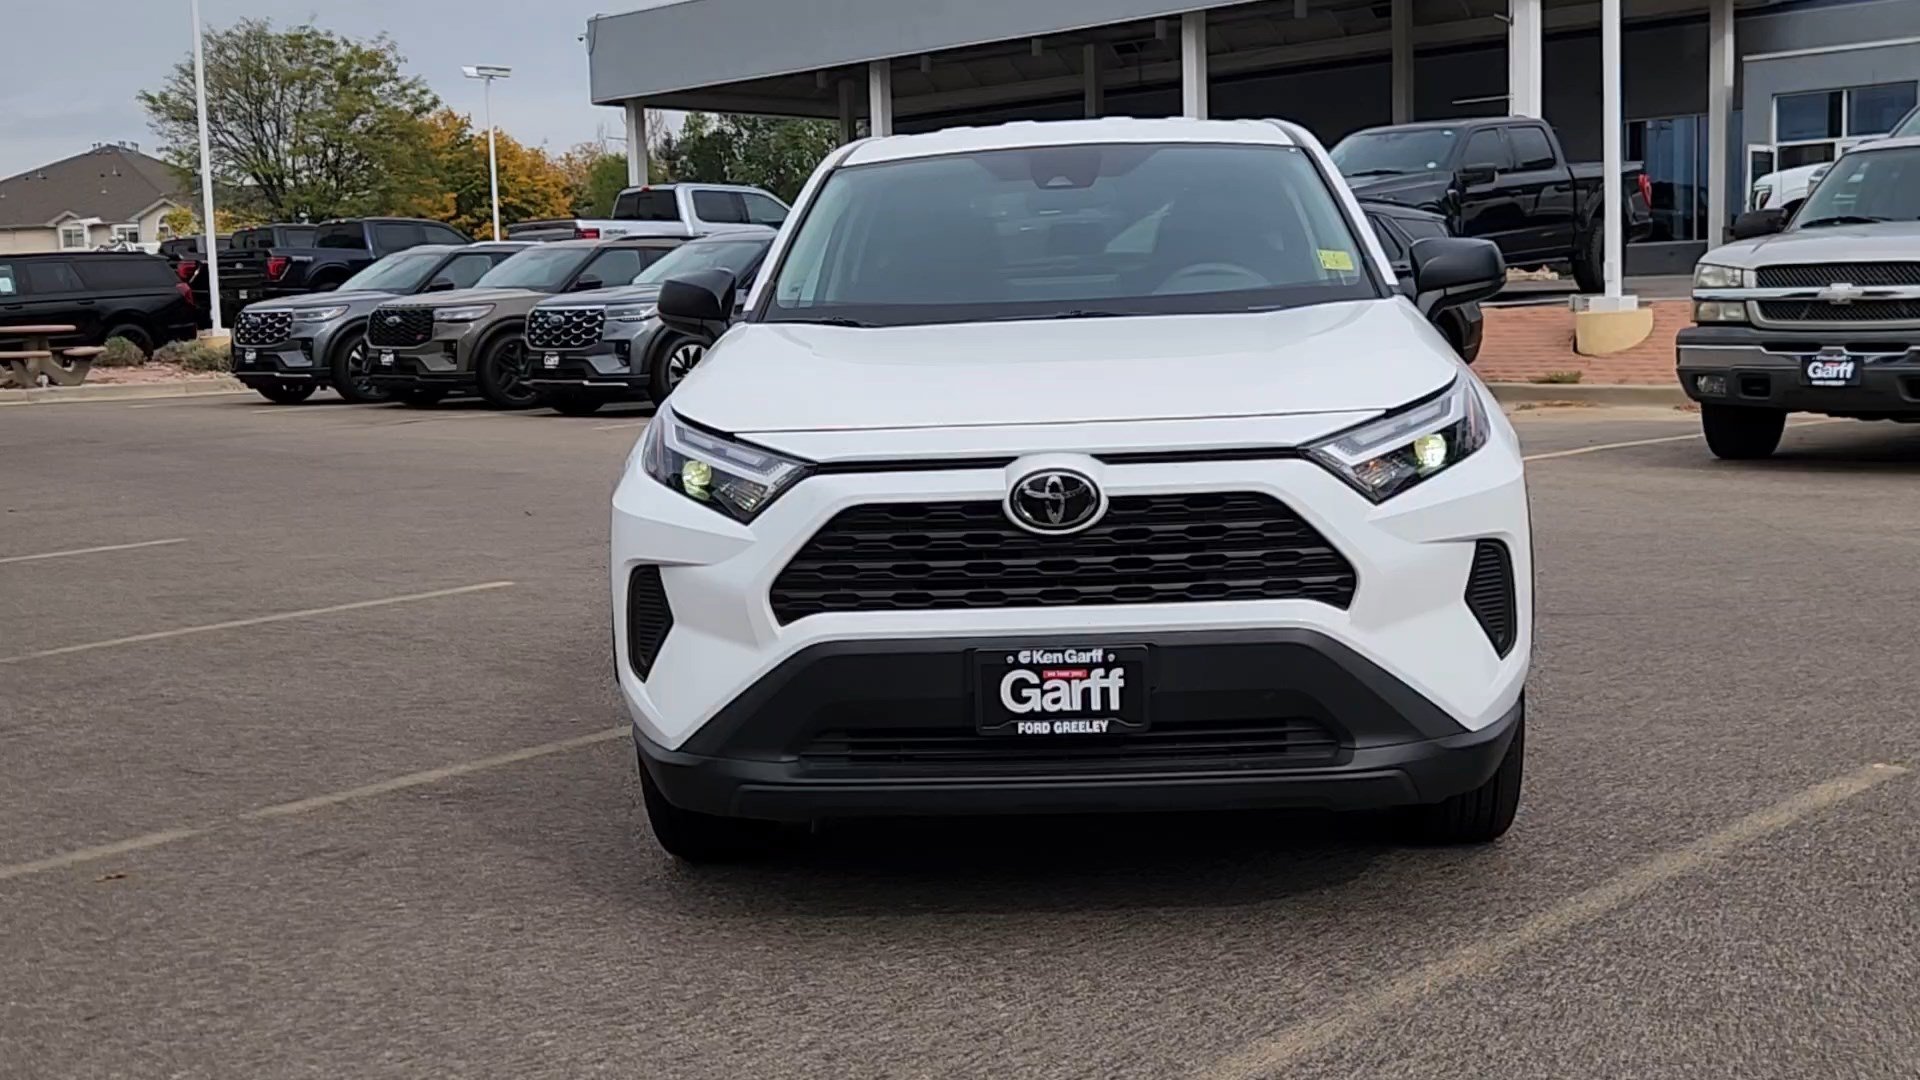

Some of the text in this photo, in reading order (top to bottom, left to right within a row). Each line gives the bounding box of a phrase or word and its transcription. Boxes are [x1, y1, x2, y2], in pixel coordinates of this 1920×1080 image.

[1807, 361, 1855, 379] Garff
[1032, 649, 1063, 664] Ken
[1064, 648, 1103, 664] Garff
[1000, 667, 1125, 714] Garff
[1017, 720, 1109, 735] FORD GREELEY
